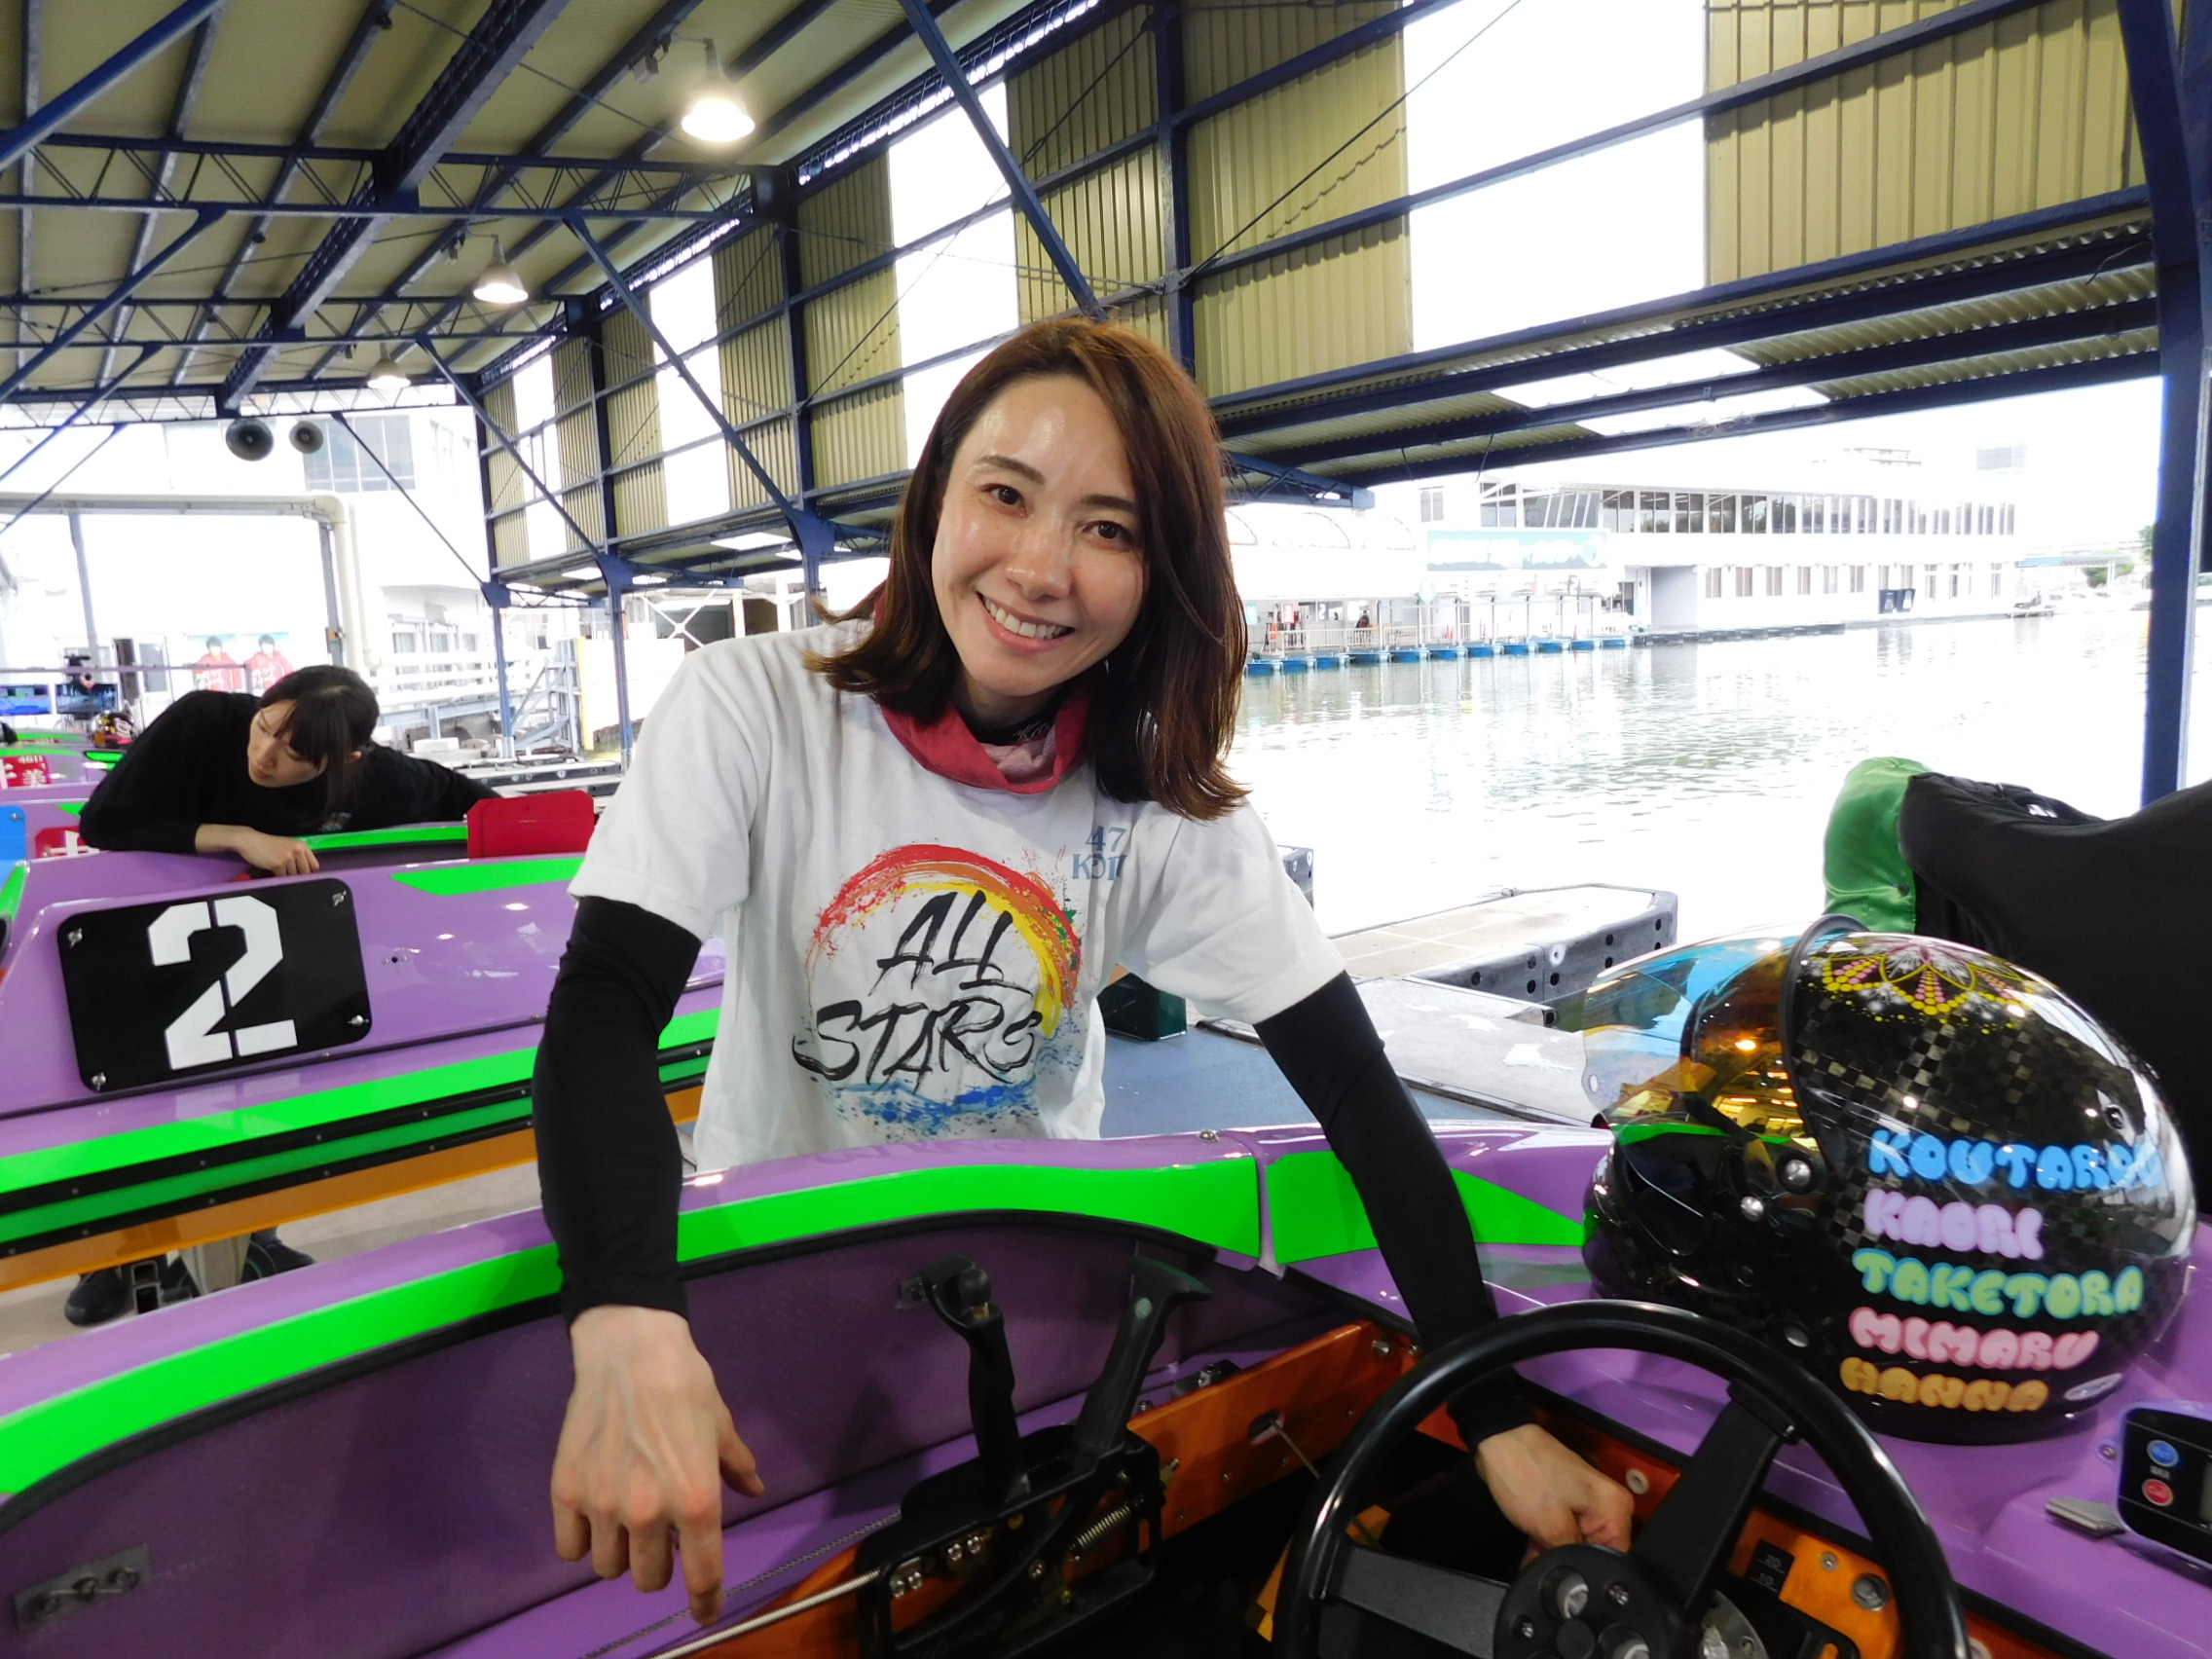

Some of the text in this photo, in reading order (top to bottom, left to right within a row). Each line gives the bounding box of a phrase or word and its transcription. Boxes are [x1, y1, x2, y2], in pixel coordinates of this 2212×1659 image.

[1085, 826, 1126, 852] 47
[868, 890, 1033, 996] ALL
[148, 896, 298, 1070] 2
[793, 996, 1043, 1093] STARS
[1853, 1248, 2142, 1318] TAKETORA
[1849, 1307, 2099, 1370] MIMARU
[1839, 1356, 2048, 1412] HANNA
